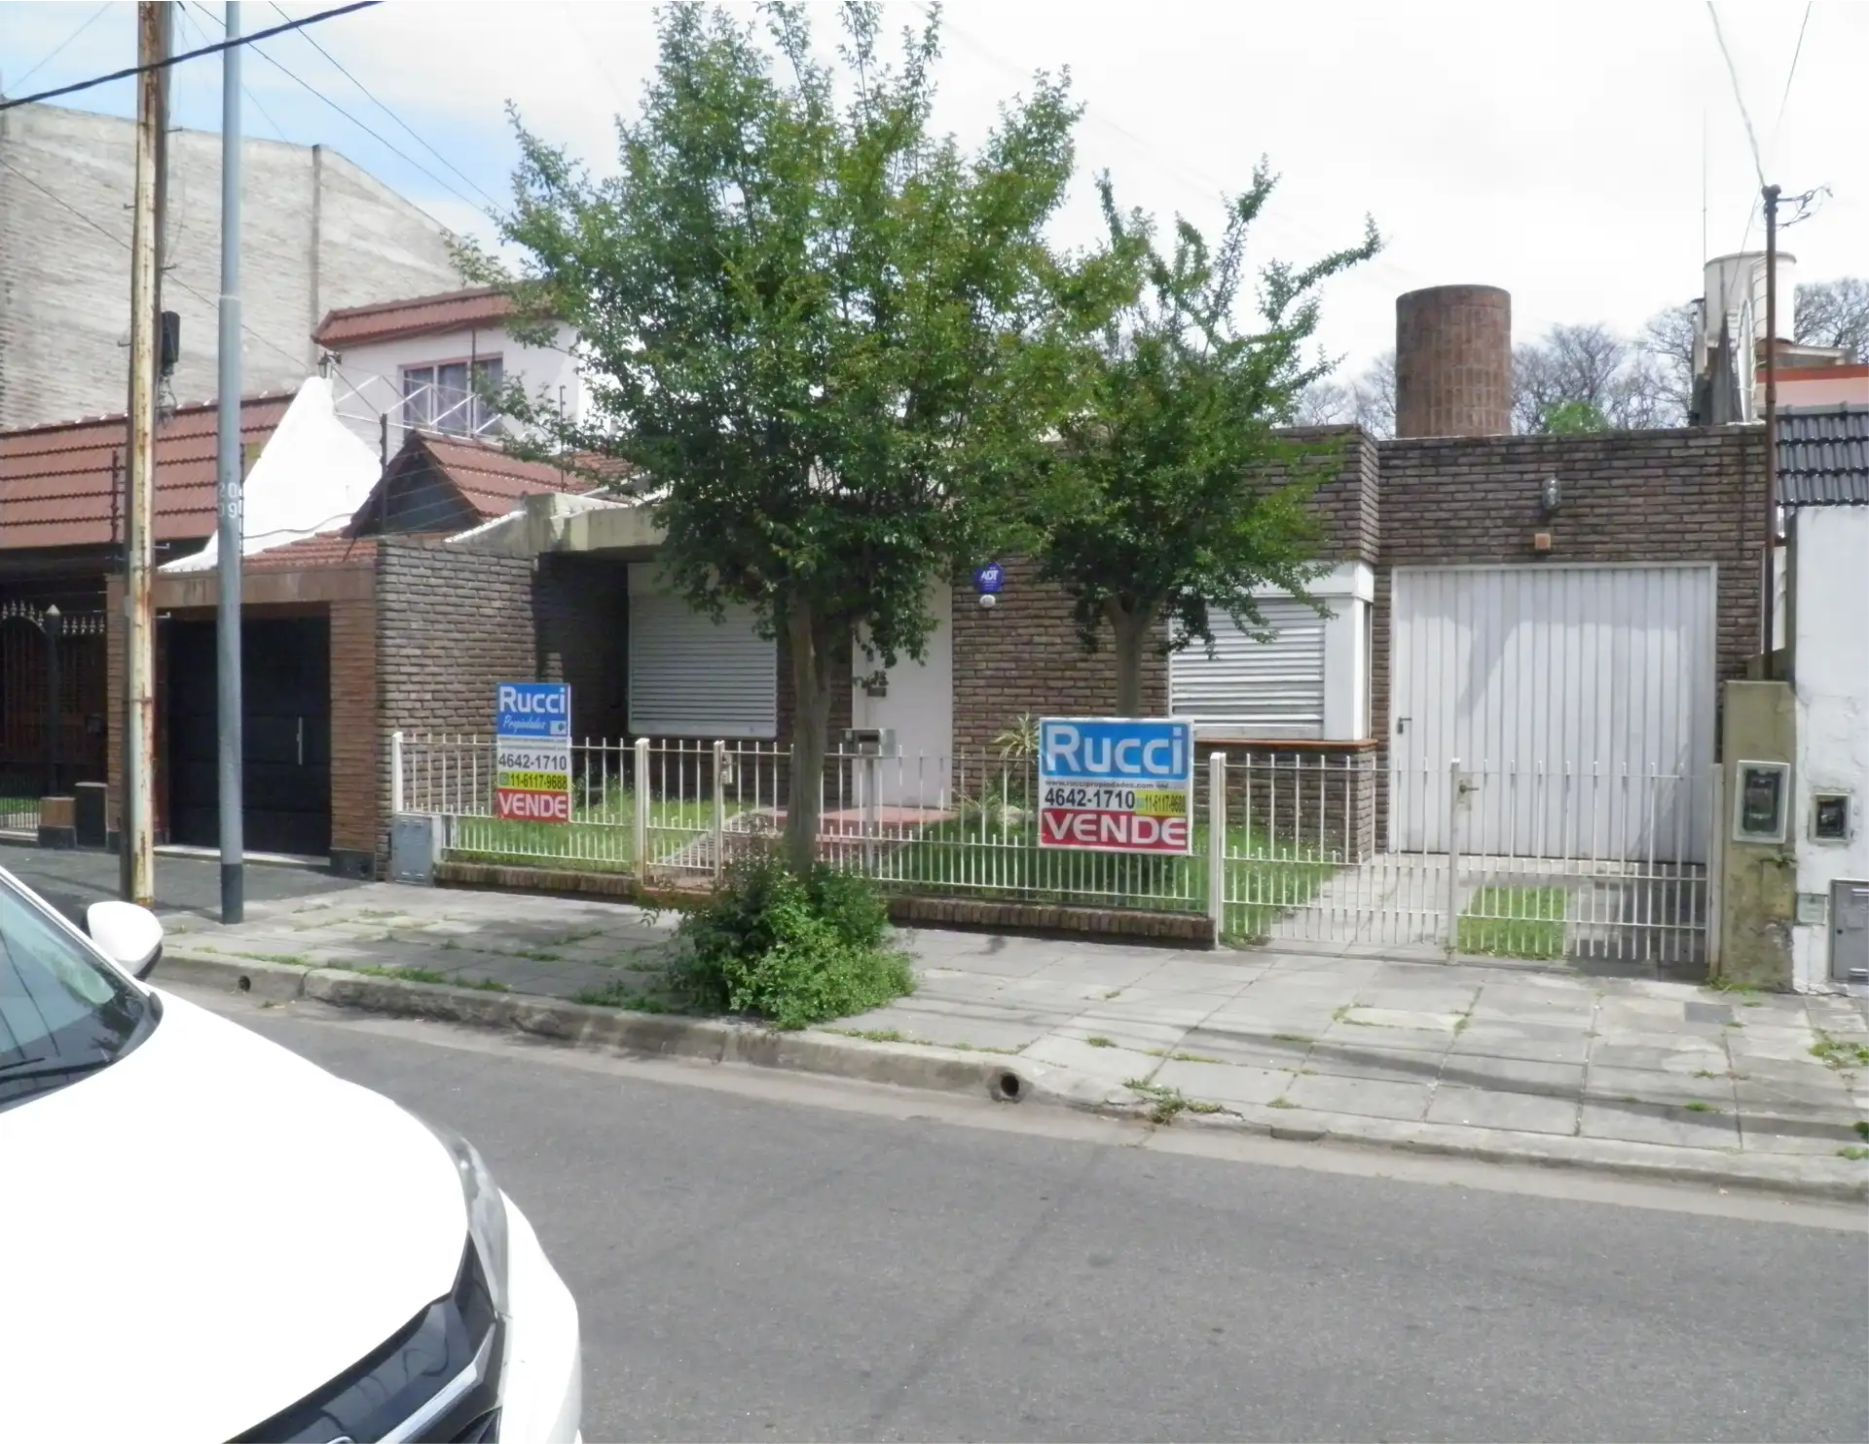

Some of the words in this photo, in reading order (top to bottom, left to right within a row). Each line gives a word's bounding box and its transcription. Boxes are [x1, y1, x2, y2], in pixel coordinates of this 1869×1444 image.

[981, 570, 999, 581] ADT
[500, 686, 566, 713] Rucci
[498, 753, 567, 770] 4642-1710
[1045, 725, 1182, 774] Rucci
[498, 792, 567, 818] VENDE
[1045, 788, 1135, 808] 4642-1710
[1043, 812, 1186, 846] VENDE
